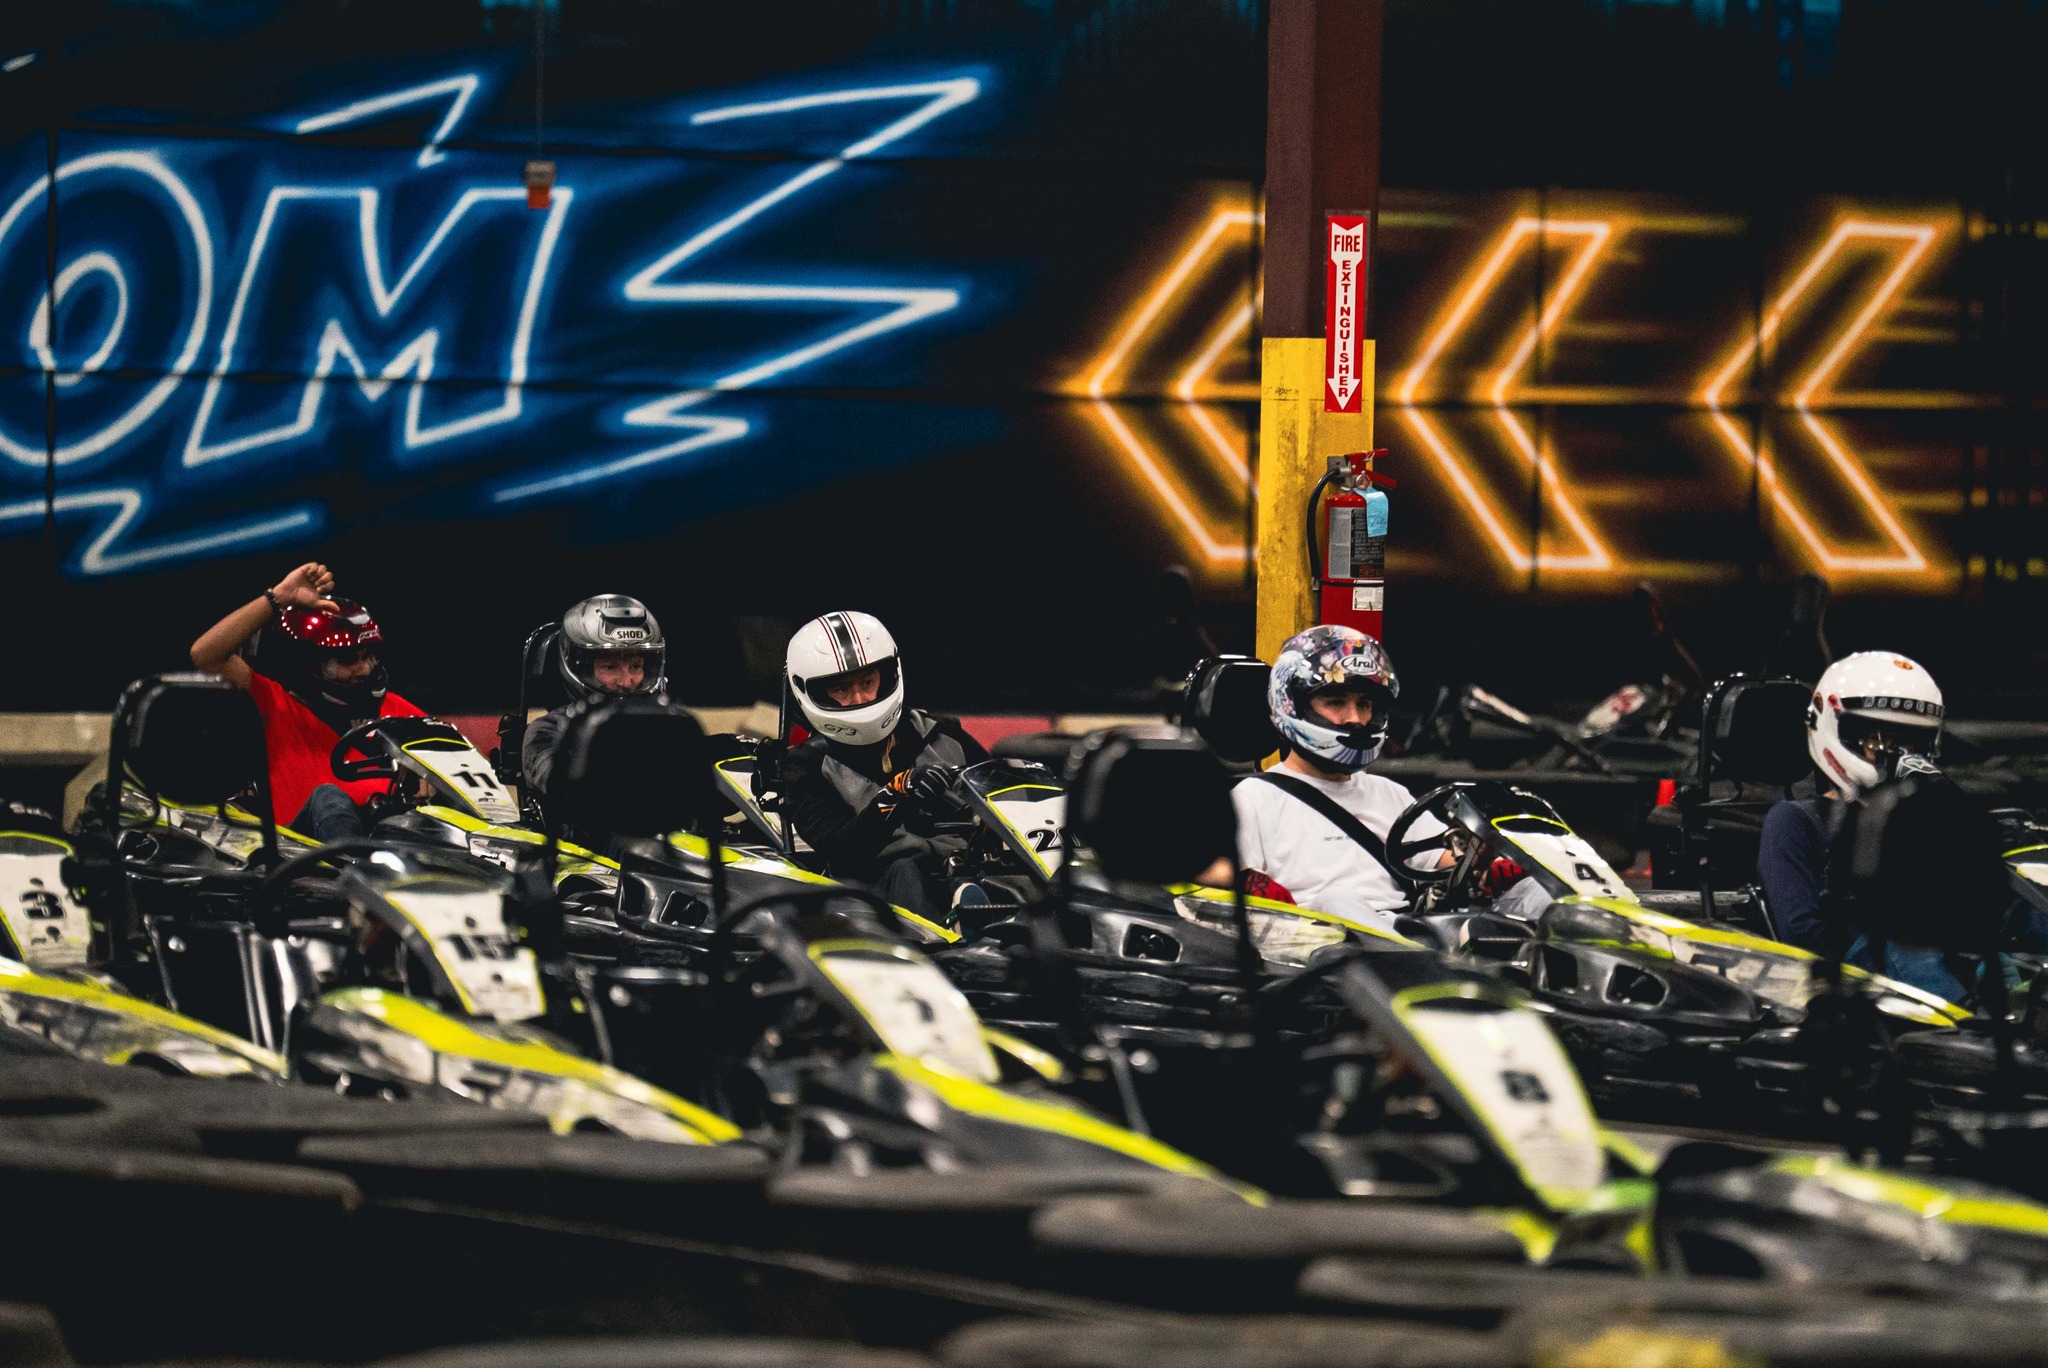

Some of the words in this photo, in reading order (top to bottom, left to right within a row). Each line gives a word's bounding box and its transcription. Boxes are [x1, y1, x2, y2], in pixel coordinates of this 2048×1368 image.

[1333, 234, 1361, 253] FIRE
[1338, 260, 1352, 398] EXTINGUISHER
[616, 630, 644, 639] SHOEI
[1343, 656, 1374, 669] Arai
[824, 723, 858, 736] GT3
[451, 771, 500, 790] 11
[1572, 862, 1607, 885] 4
[19, 890, 67, 920] 3
